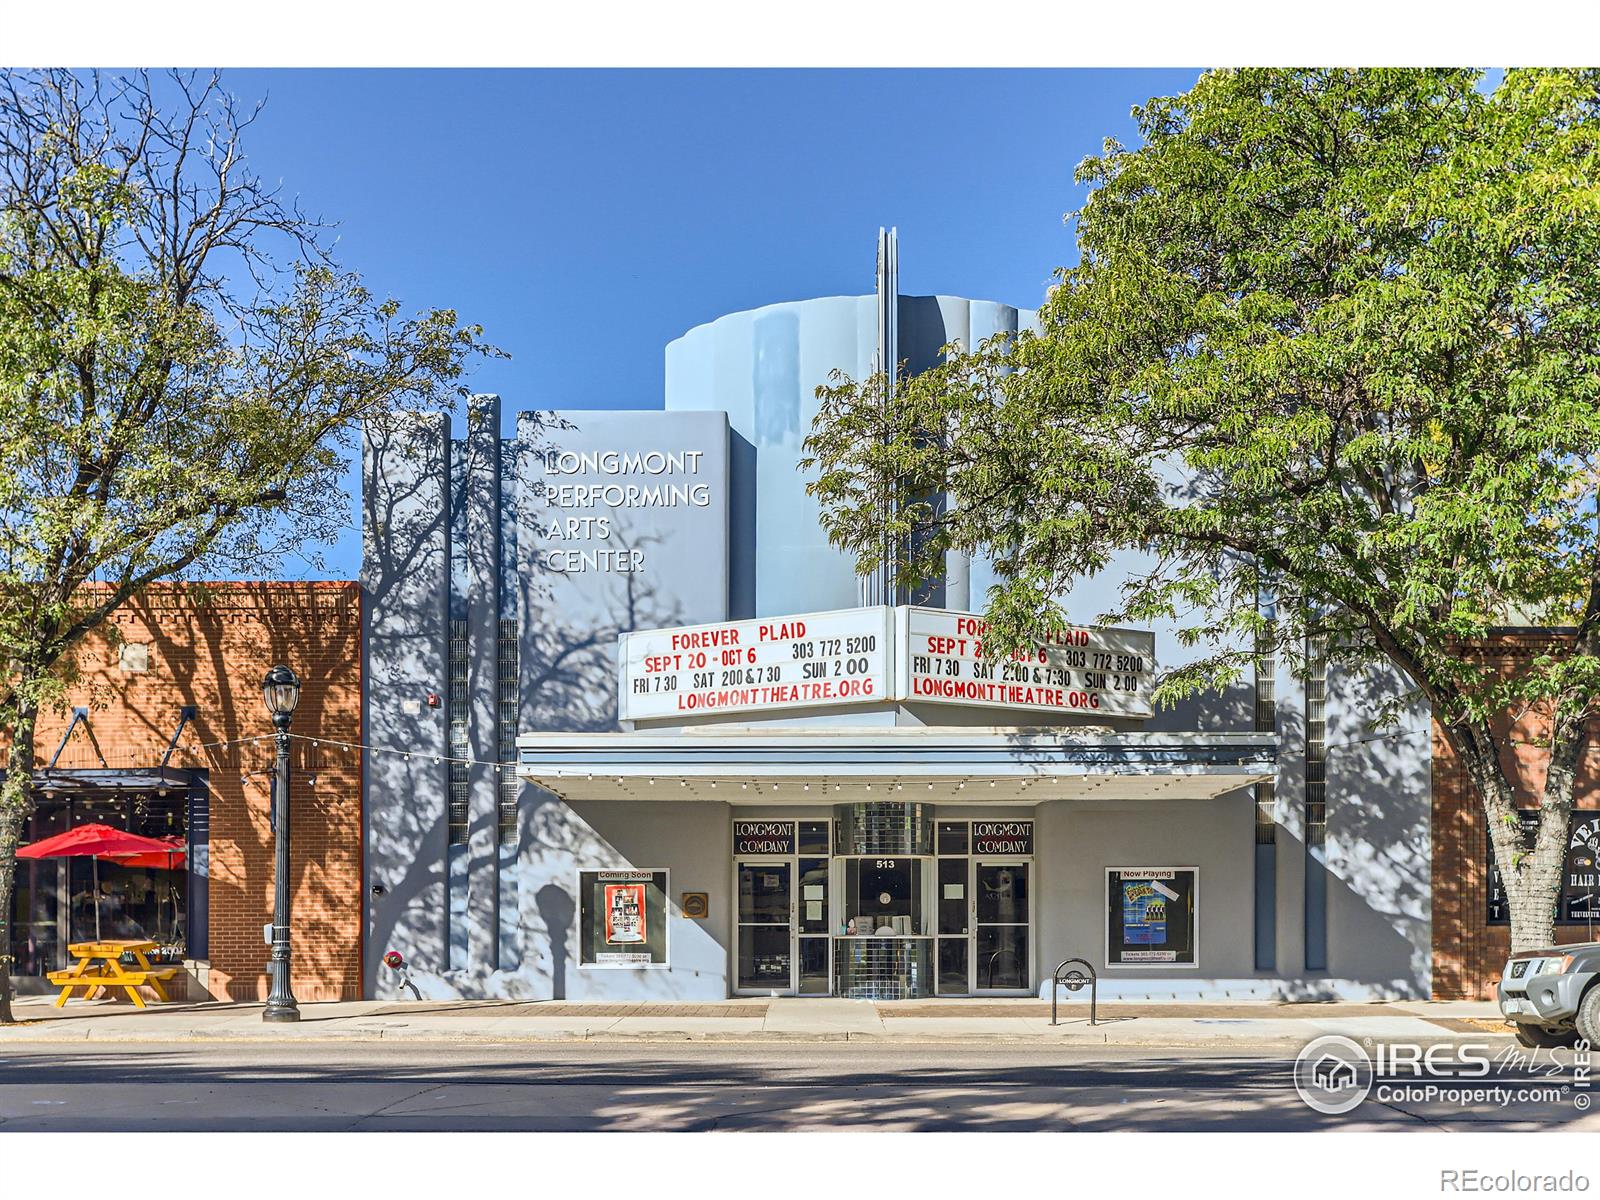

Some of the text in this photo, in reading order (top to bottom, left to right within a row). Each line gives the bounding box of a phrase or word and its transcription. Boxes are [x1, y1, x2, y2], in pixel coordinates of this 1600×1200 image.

[545, 451, 703, 475] LONGMONT
[546, 484, 710, 507] PERFORMING
[547, 517, 610, 540] ARTS
[547, 549, 645, 573] CENTER
[672, 622, 806, 650] FOREVER PLAID
[645, 655, 681, 673] SEPT
[688, 652, 706, 669] 20
[722, 649, 742, 666] OCT
[748, 647, 757, 663] 6
[793, 642, 814, 659] 303
[820, 639, 842, 656] 772
[847, 635, 876, 654] 5200
[928, 636, 966, 656] SEPT
[1038, 647, 1047, 663] 6
[1066, 650, 1086, 667] 303
[1093, 653, 1112, 669] 772
[1117, 656, 1142, 672] 5200
[634, 678, 650, 693] FRI
[694, 672, 714, 688] SAT
[803, 662, 826, 679] SUN
[914, 657, 930, 673] FRI
[974, 662, 993, 679] SAT
[1033, 667, 1041, 683] &
[1046, 669, 1070, 686] 7:30
[1085, 672, 1106, 689] SUN
[678, 678, 873, 709] LONGMONTTHEATRE.ORG
[914, 678, 1099, 708] LONGMONTTHEATRE.ORG
[736, 824, 793, 835] LONGMONT
[974, 824, 1031, 835] LONGMONT
[740, 841, 789, 853] COMPANY
[978, 841, 1027, 853] COMPANY
[600, 871, 629, 879] Coming
[876, 860, 895, 868] 513
[1570, 874, 1595, 887] HAIR
